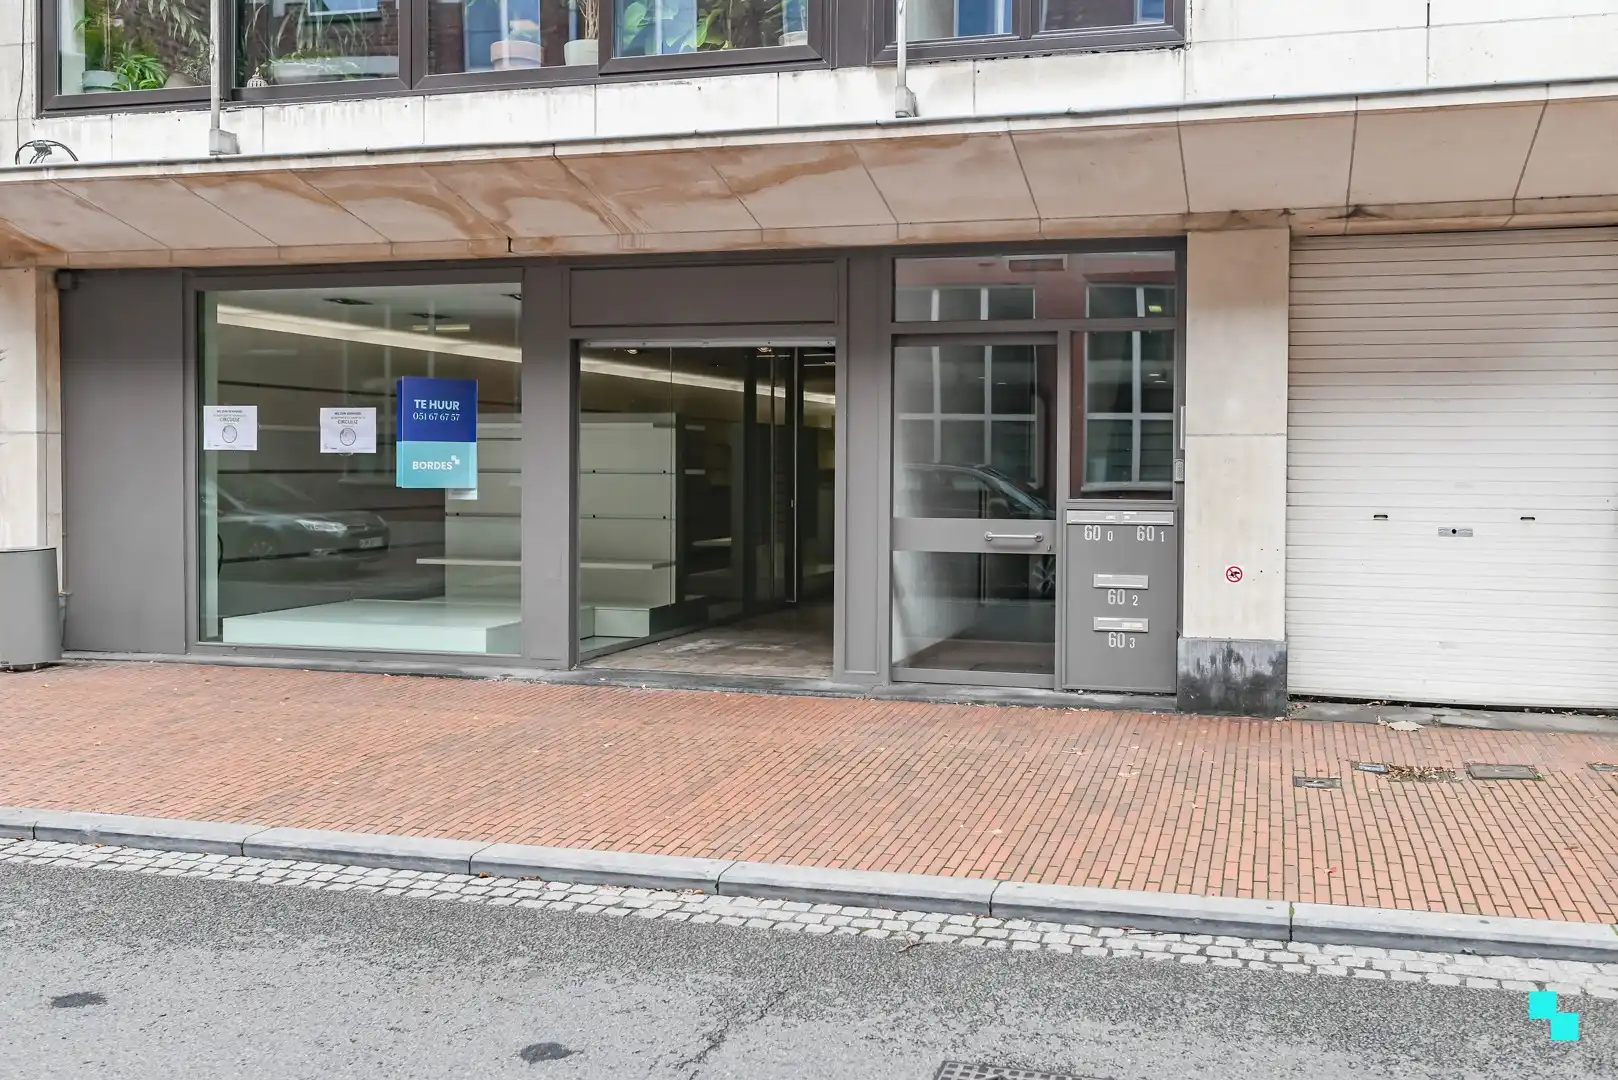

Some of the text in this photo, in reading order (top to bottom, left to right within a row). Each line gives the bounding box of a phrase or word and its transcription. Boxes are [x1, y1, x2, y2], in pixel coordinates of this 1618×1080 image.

[414, 399, 460, 410] TE HUUR
[412, 411, 461, 422] 051 67 67 57
[412, 461, 453, 470] BORDES
[1084, 524, 1114, 542] 60 0
[1136, 525, 1165, 542] 60 1
[1107, 588, 1138, 606] 60 2
[1108, 631, 1136, 649] 60 3
